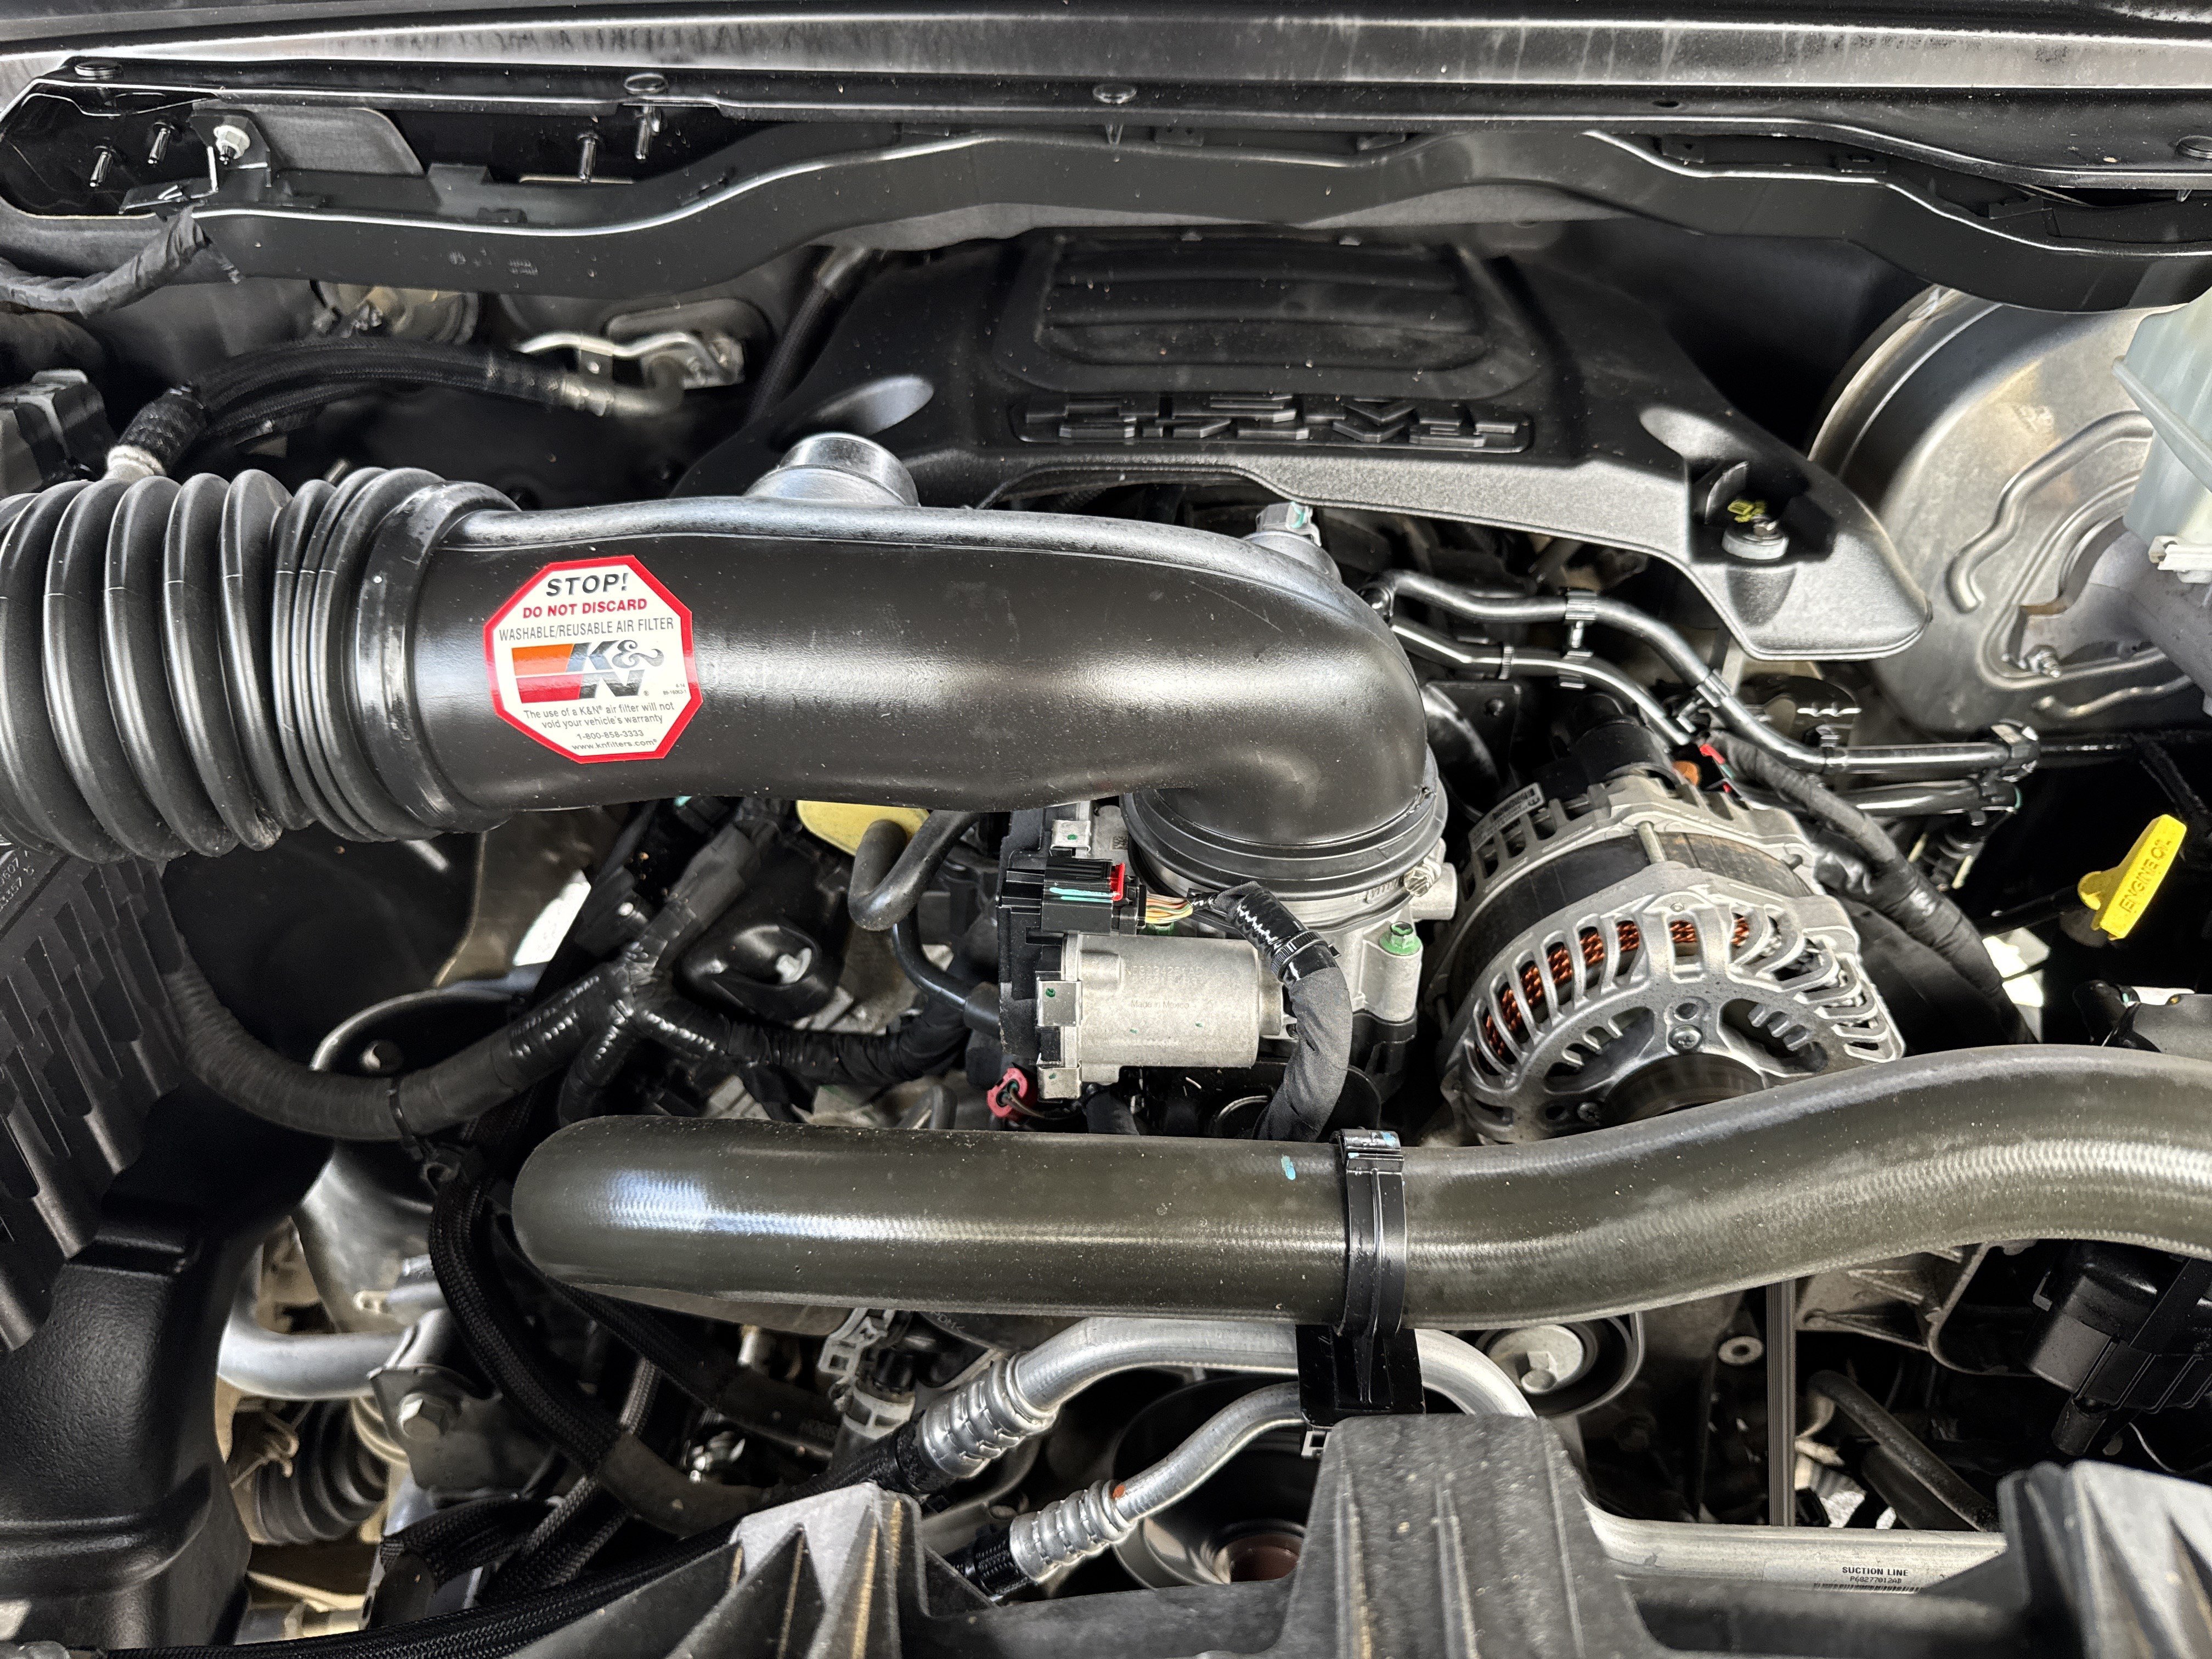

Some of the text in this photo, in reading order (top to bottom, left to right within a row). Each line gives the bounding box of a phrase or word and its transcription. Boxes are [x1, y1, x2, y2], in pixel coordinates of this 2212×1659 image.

[546, 573, 629, 597] STOP!
[523, 598, 648, 619] DO NOT DISCARD
[499, 617, 674, 641] WASHABLE/REUSABLE AIR FILTER
[523, 709, 541, 719] The
[561, 708, 569, 716] of
[606, 705, 617, 714] air
[619, 703, 639, 713] filter
[641, 702, 657, 712] will
[659, 701, 675, 710] not
[541, 714, 663, 730] void your vehicle's warranty
[576, 730, 644, 740] 1-800-858-3333
[2119, 858, 2159, 913] ENGINE
[1131, 1000, 1152, 1008] Made
[1163, 1000, 1189, 1009] Mexico
[1842, 1566, 1883, 1575] SUCTION
